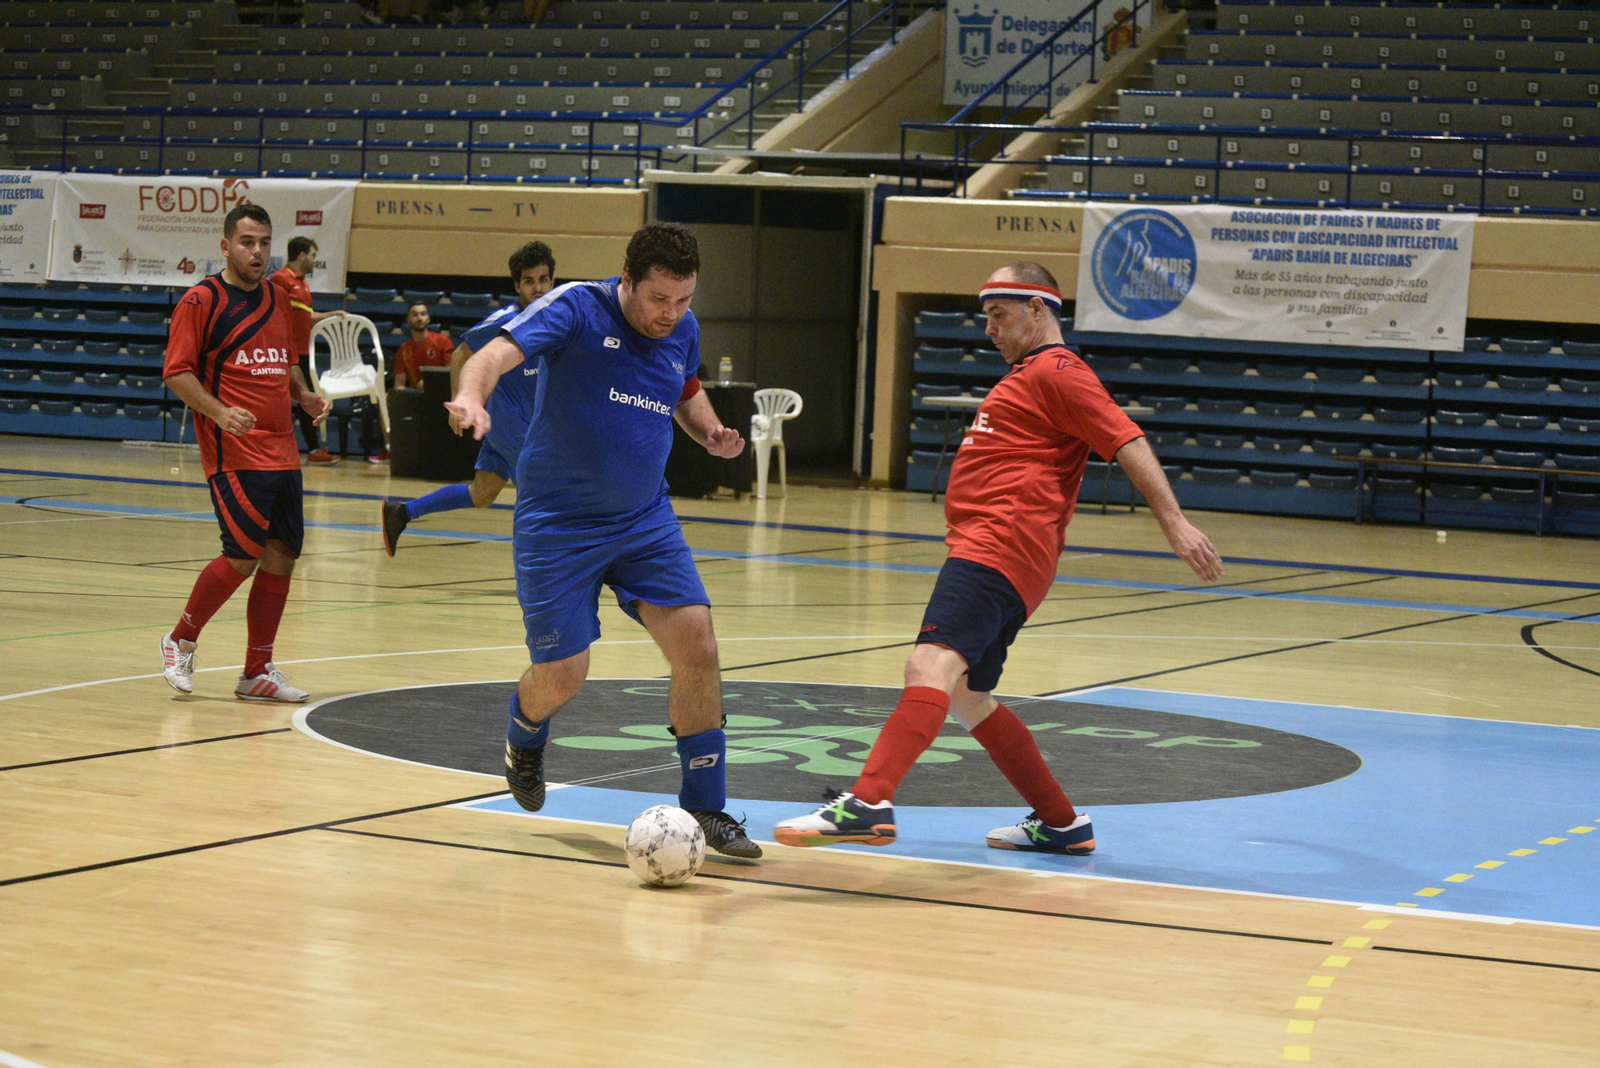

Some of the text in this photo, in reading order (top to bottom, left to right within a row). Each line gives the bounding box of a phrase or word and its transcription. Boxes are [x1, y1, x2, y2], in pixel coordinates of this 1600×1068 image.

[997, 38, 1016, 54] de
[376, 200, 446, 216] PRENSA
[996, 216, 1077, 234] PRENSA
[1231, 210, 1441, 232] ASOCIACIÓN DE PADRES Y MADRES DE
[1211, 227, 1459, 251] PERSONAS CON DISCAPACIDAD INTELECTUAL
[1296, 248, 1331, 264] BAHÍA
[1334, 250, 1349, 265] DE
[1144, 256, 1191, 276] APADIS
[1261, 270, 1276, 281] de
[1278, 270, 1292, 282] 55
[1294, 272, 1322, 284] años
[1326, 274, 1394, 288] trabajando
[1394, 277, 1428, 289] junto
[1232, 284, 1428, 304] a las personas con discapacidad
[1287, 303, 1369, 316] y sus familias
